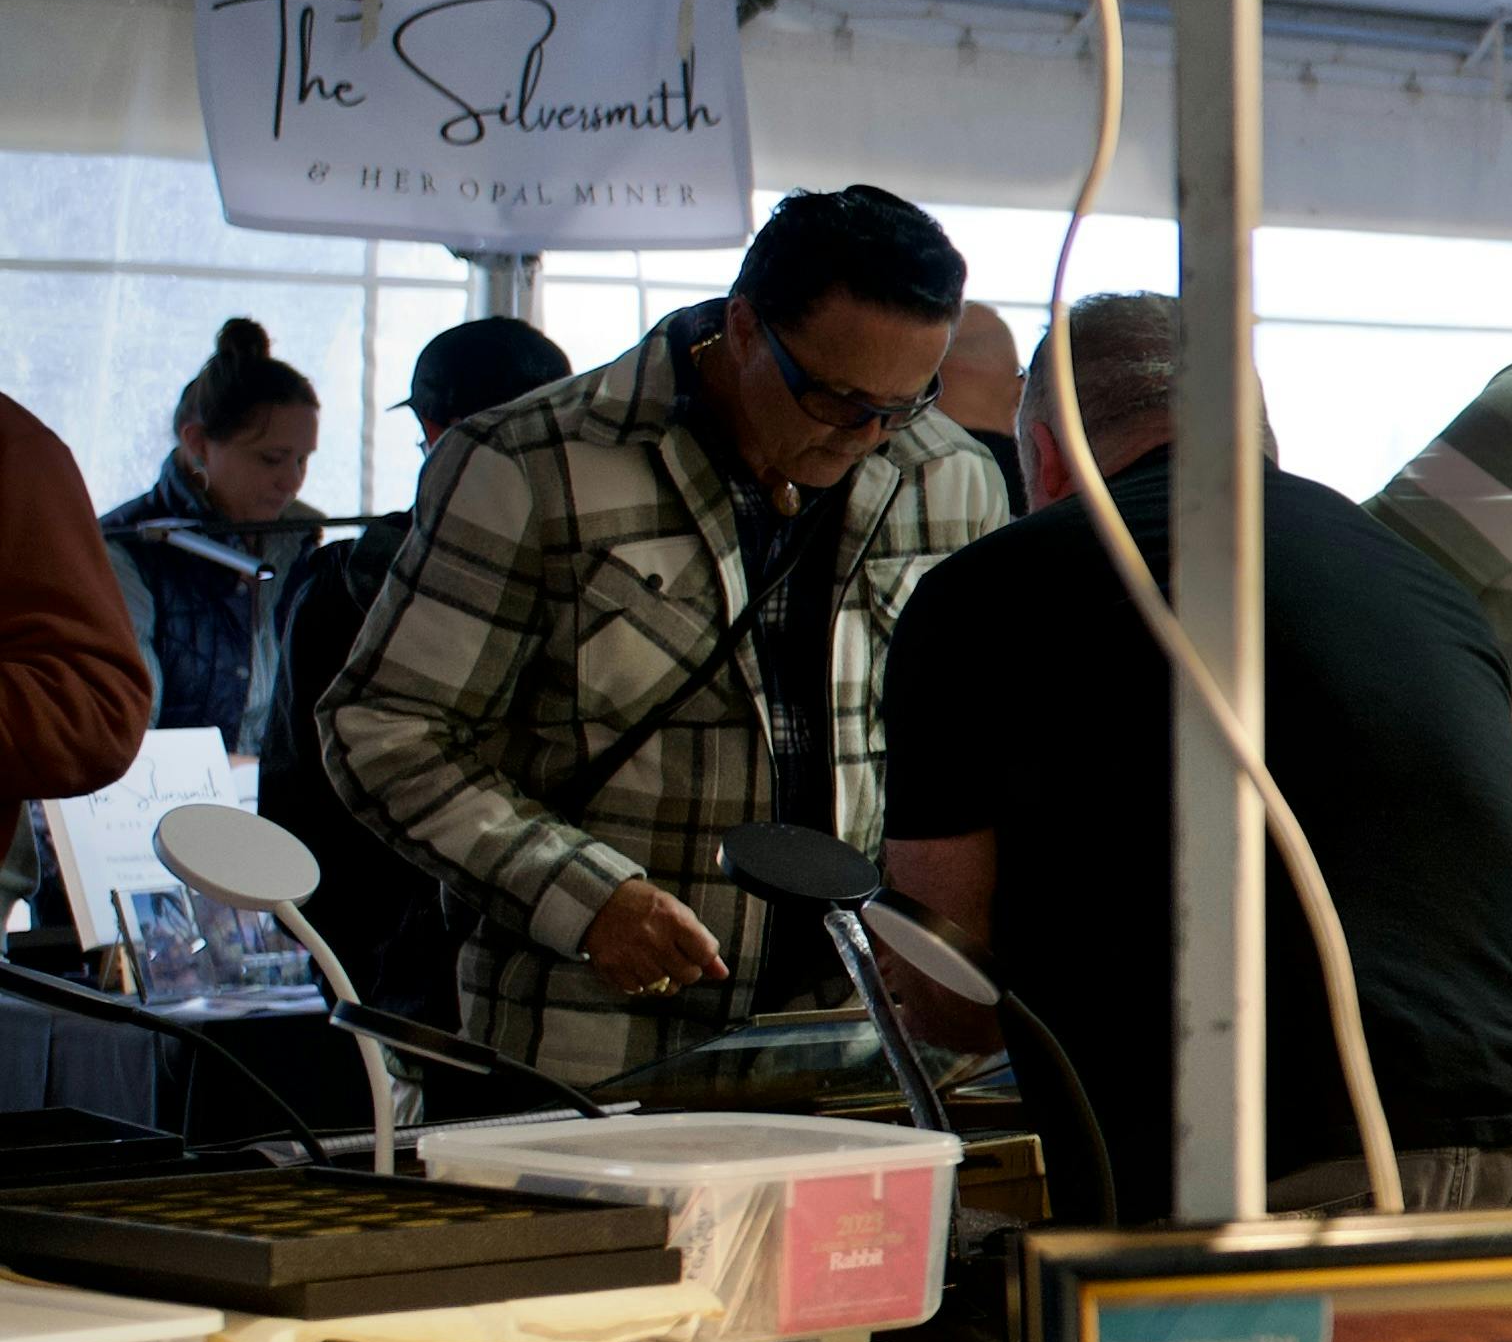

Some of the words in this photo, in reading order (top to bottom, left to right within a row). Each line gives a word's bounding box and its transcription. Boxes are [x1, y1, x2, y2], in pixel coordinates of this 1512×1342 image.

[307, 159, 332, 184] &
[360, 163, 441, 199] HER
[458, 173, 553, 209] OPAL
[575, 178, 698, 210] MINER
[829, 1247, 884, 1273] Rabbit
